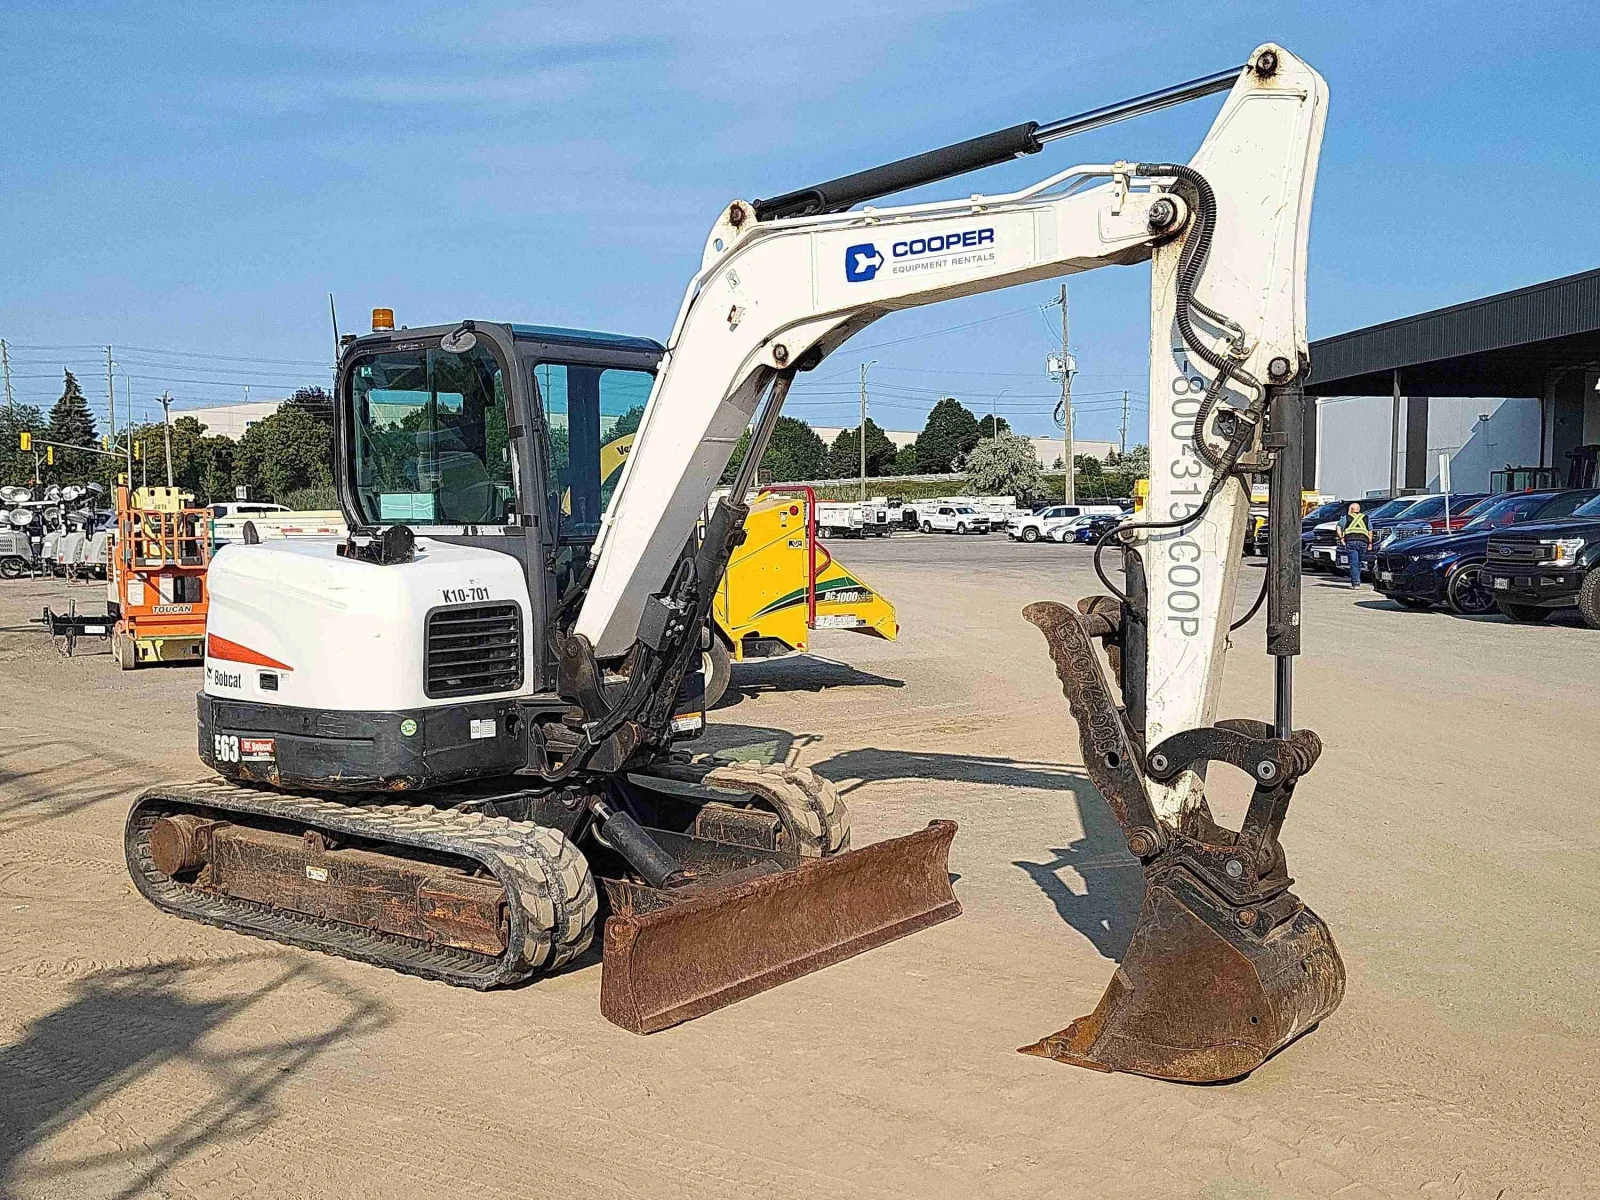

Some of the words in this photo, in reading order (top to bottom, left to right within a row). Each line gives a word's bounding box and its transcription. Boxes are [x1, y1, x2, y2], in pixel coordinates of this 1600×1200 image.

[893, 228, 994, 257] COOPER
[892, 259, 948, 274] EQUIPMENT
[950, 252, 995, 266] RENTALS
[442, 587, 490, 603] K10-701
[152, 605, 192, 614] TOUCAN
[214, 669, 242, 689] Bobcat
